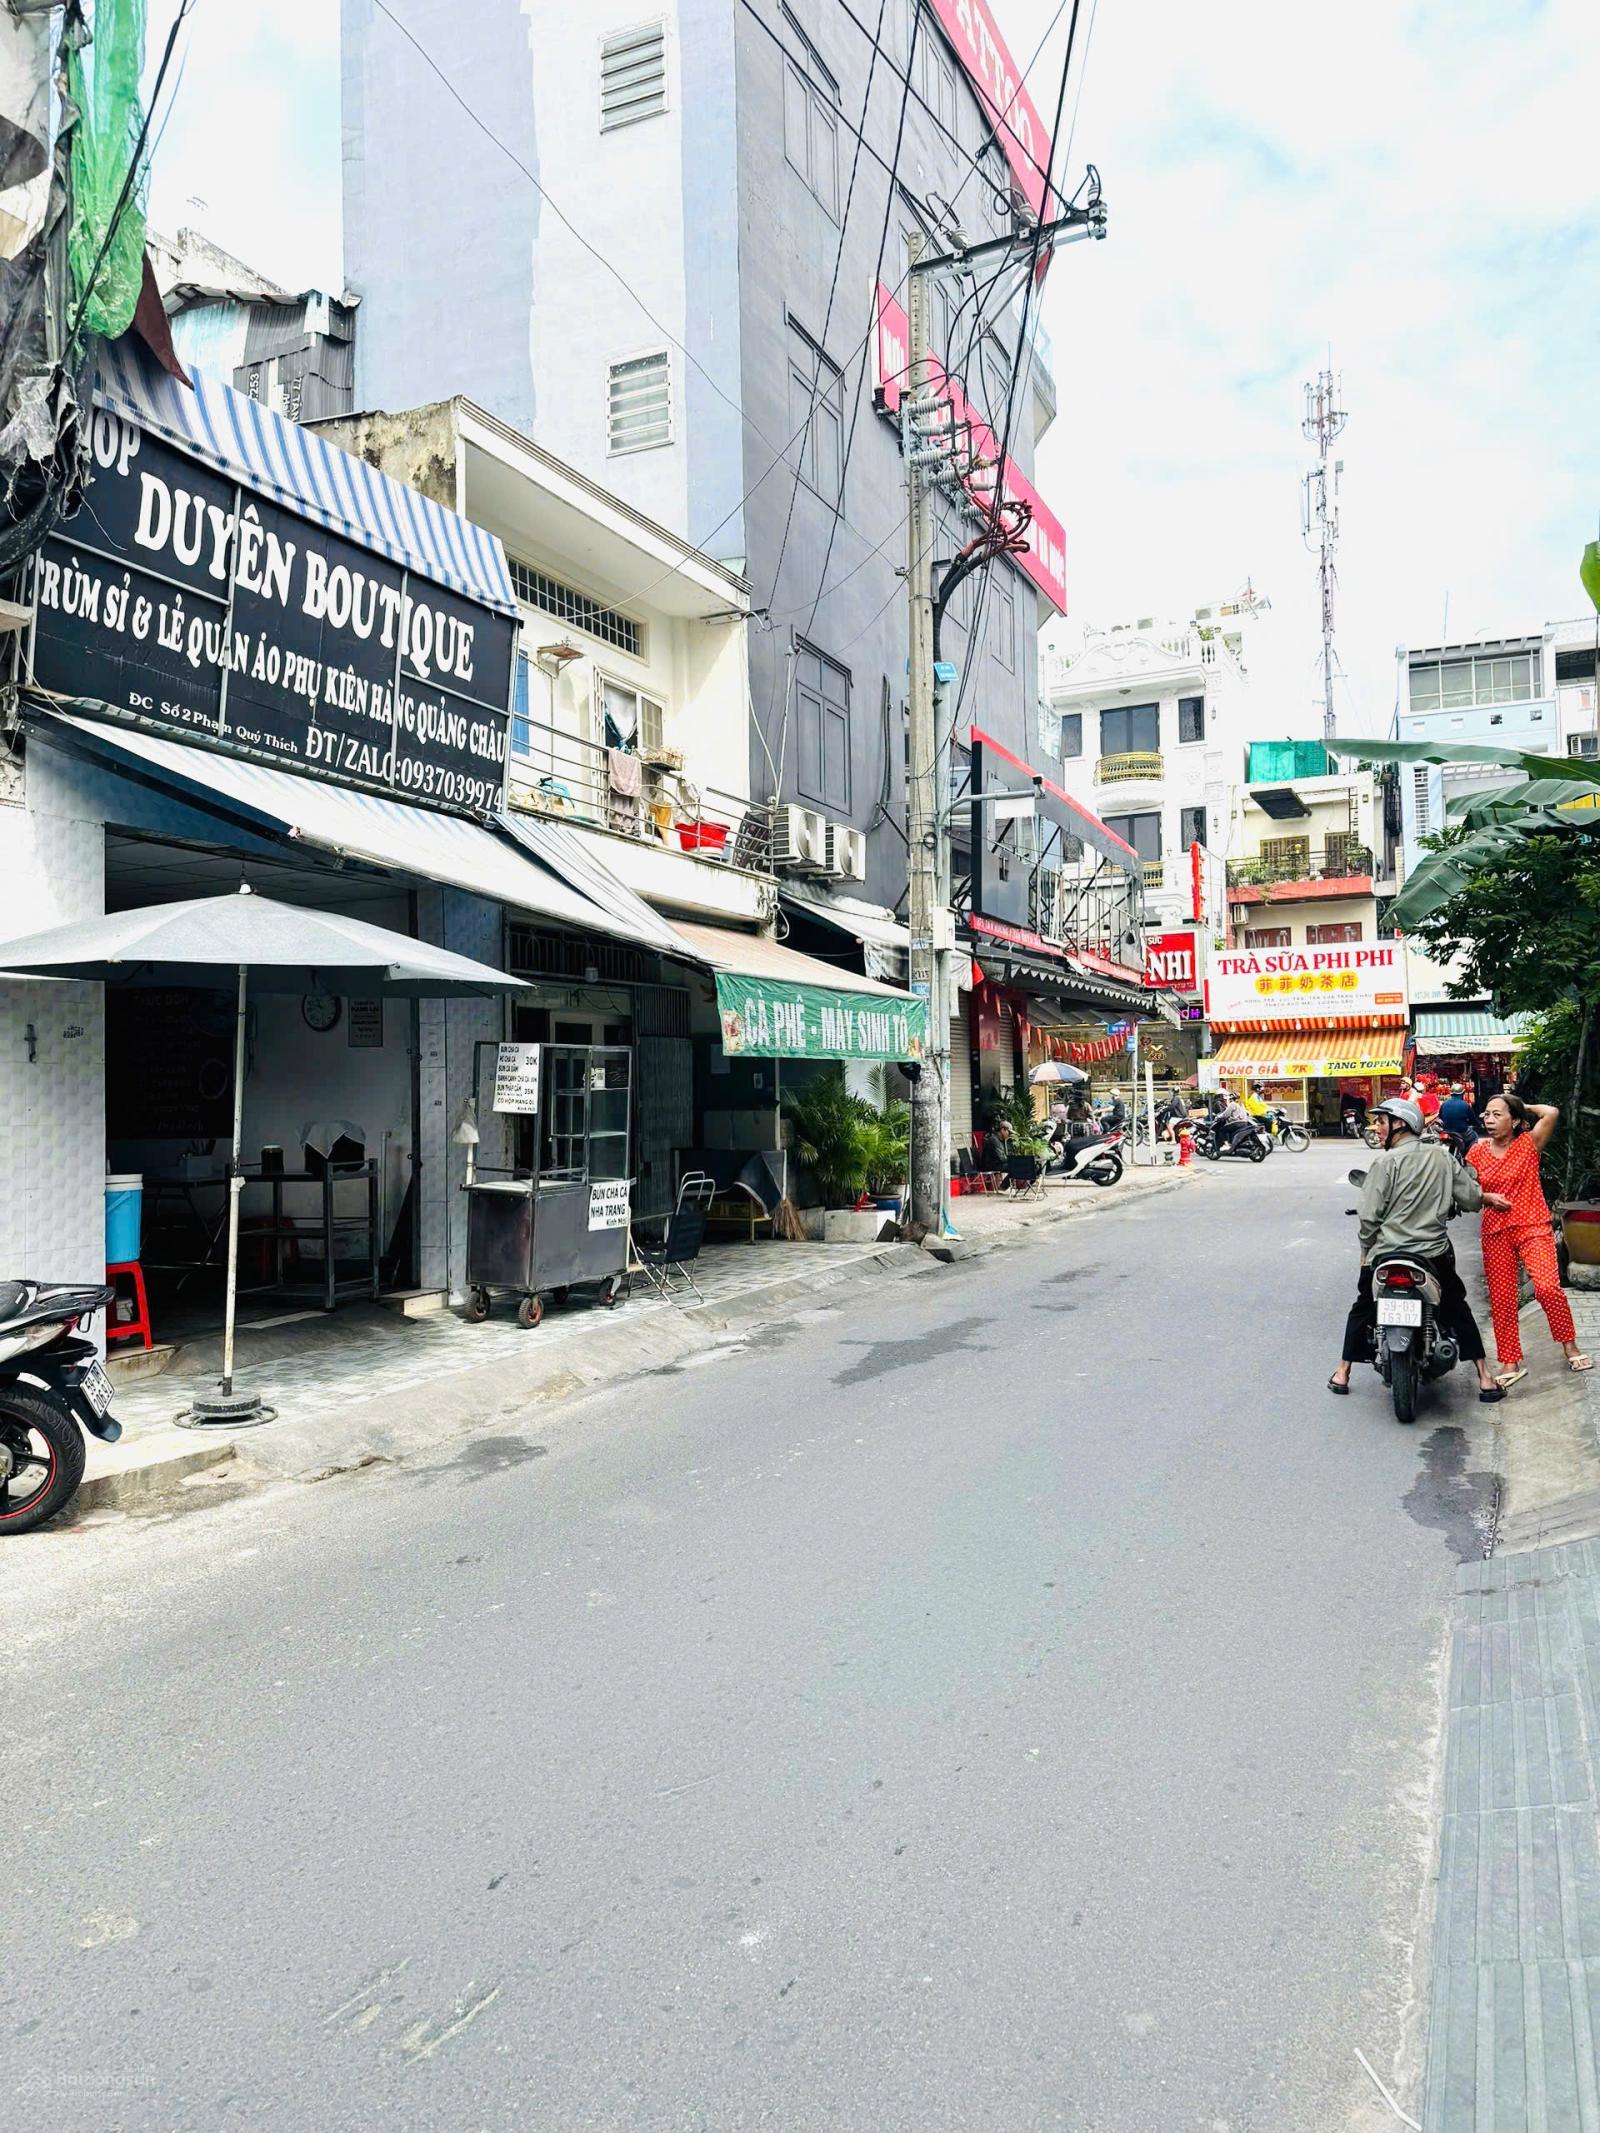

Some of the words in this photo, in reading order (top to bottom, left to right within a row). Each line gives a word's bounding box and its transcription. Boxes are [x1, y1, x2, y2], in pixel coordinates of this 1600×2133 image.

[134, 472, 297, 608] DUYÊN
[302, 549, 475, 683] BOUTIQUE
[103, 572, 131, 633] SỈ
[132, 596, 153, 640] &
[157, 593, 185, 653] LẺ
[282, 650, 323, 707] PHỤ
[324, 663, 369, 716] KIỆN
[369, 679, 416, 732] HÀNG
[416, 696, 468, 750] QUẢNG
[469, 719, 507, 763] CHÂU
[128, 692, 153, 710] ĐC
[160, 702, 180, 718] Số
[182, 708, 192, 722] 2
[192, 711, 232, 734] Phạm
[235, 725, 262, 744] Quý
[263, 733, 298, 754] Thích
[1148, 949, 1193, 982] NHI
[1217, 951, 1261, 975] TRÀ
[1265, 950, 1308, 973] SỮA
[1313, 952, 1350, 970] PHI
[1355, 949, 1393, 968] PHI
[1259, 974, 1355, 992] 菲菲奶茶店
[773, 993, 807, 1048] PHÊ
[819, 999, 854, 1051] MÁY
[857, 1010, 890, 1053] SINH
